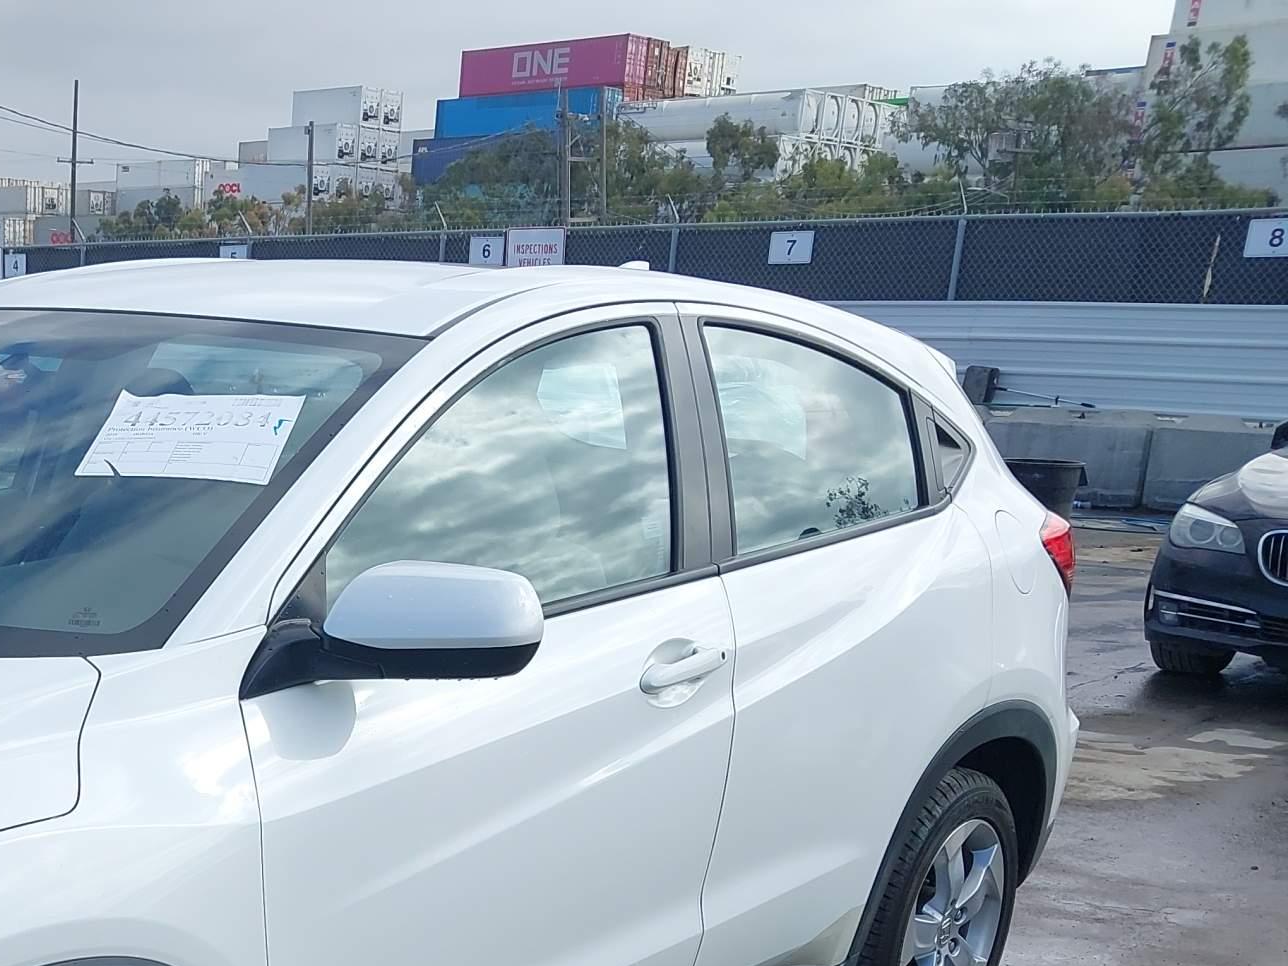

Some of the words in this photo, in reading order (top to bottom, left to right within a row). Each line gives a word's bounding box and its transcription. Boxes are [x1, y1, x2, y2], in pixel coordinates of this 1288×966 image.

[512, 47, 571, 78] ONE
[1269, 228, 1285, 247] 8
[482, 244, 491, 259] 6
[513, 243, 558, 255] INSPECTIONS
[786, 239, 797, 256] 7
[12, 259, 19, 272] 4
[518, 258, 552, 267] VEHICLES
